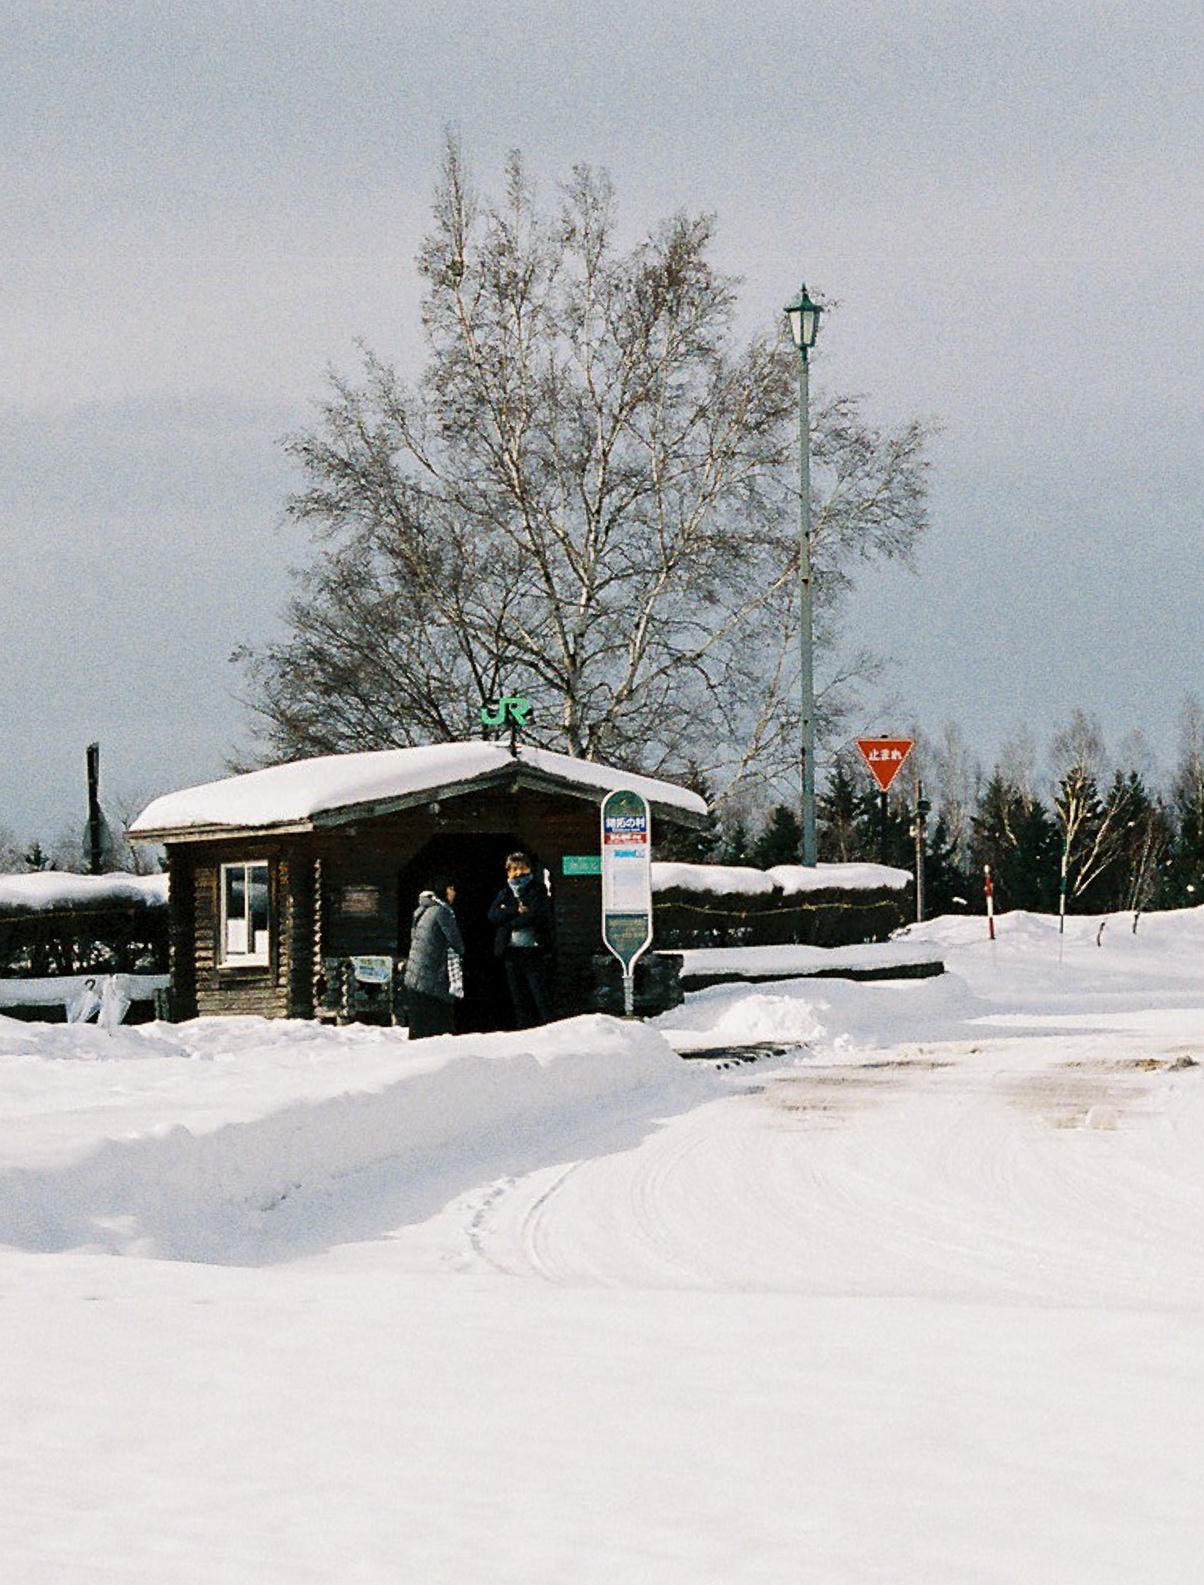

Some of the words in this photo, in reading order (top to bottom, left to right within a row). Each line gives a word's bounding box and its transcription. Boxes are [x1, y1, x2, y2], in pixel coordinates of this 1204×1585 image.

[481, 697, 529, 726] JR
[868, 748, 902, 761] 止まれ
